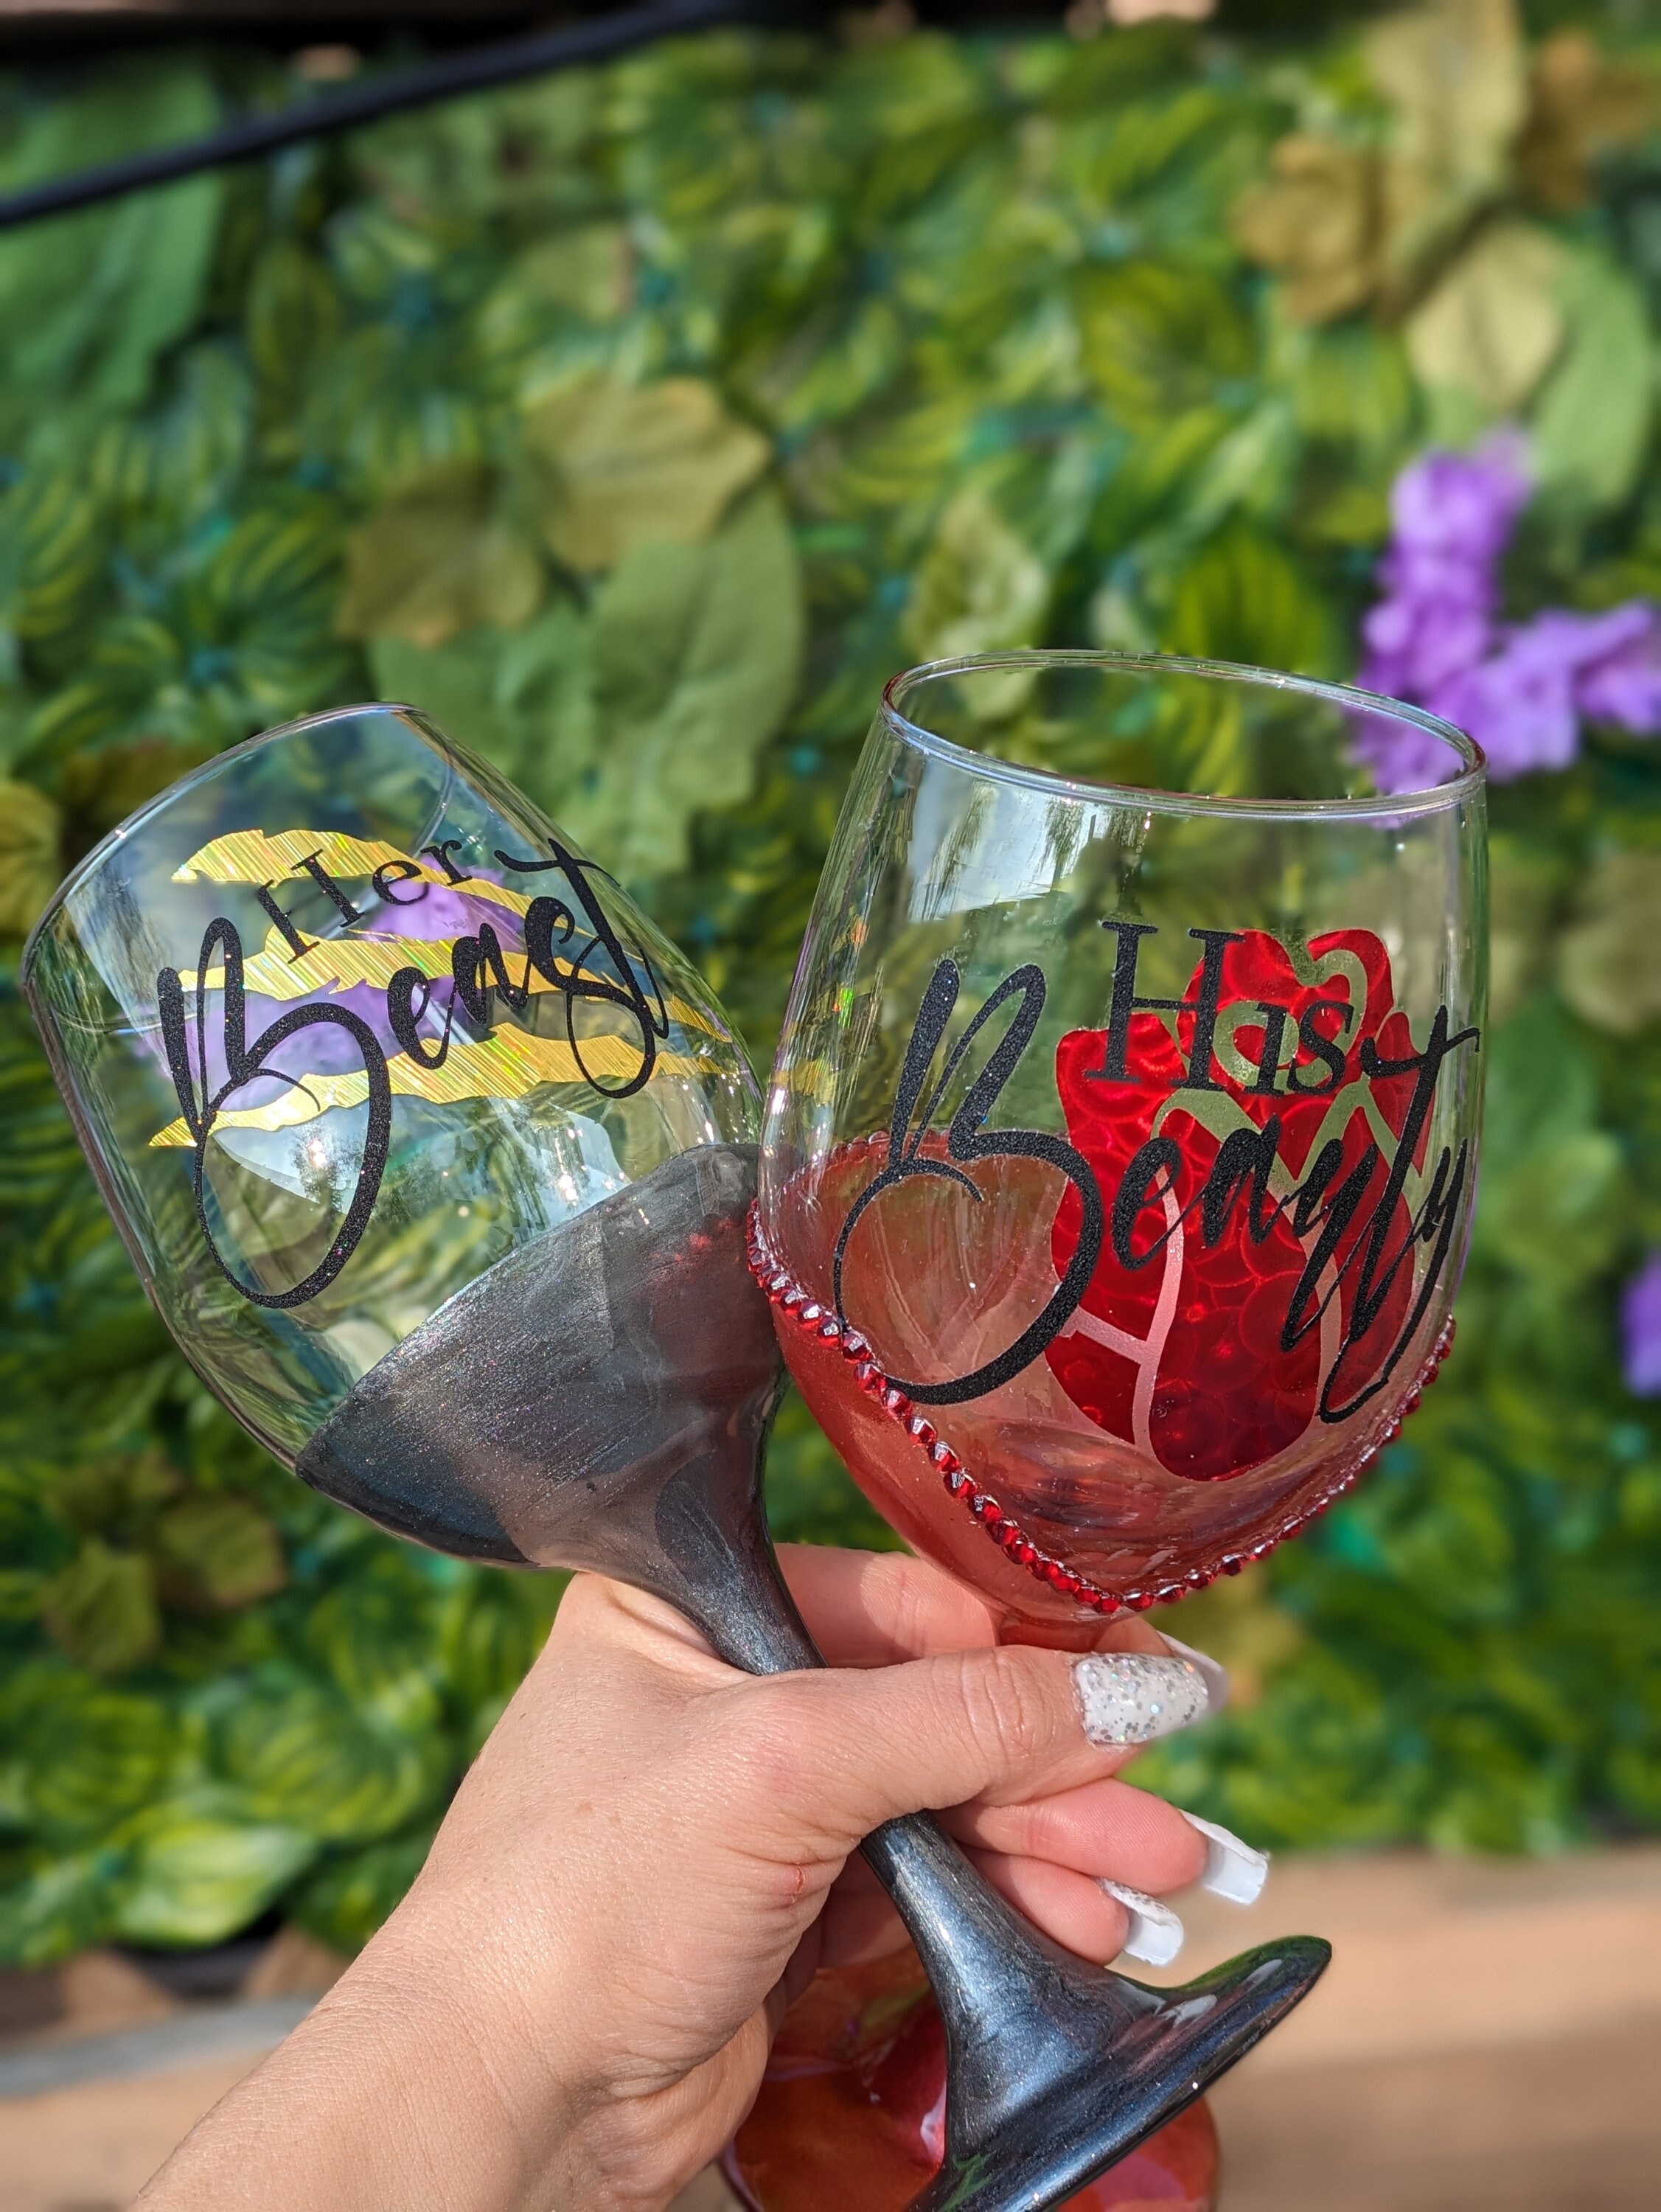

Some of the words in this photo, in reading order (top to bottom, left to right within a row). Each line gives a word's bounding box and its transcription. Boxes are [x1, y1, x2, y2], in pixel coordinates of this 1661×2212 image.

[258, 840, 473, 964] Her
[1084, 920, 1354, 1096] His
[156, 838, 669, 1310] Beast
[833, 959, 1480, 1424] Beauty
